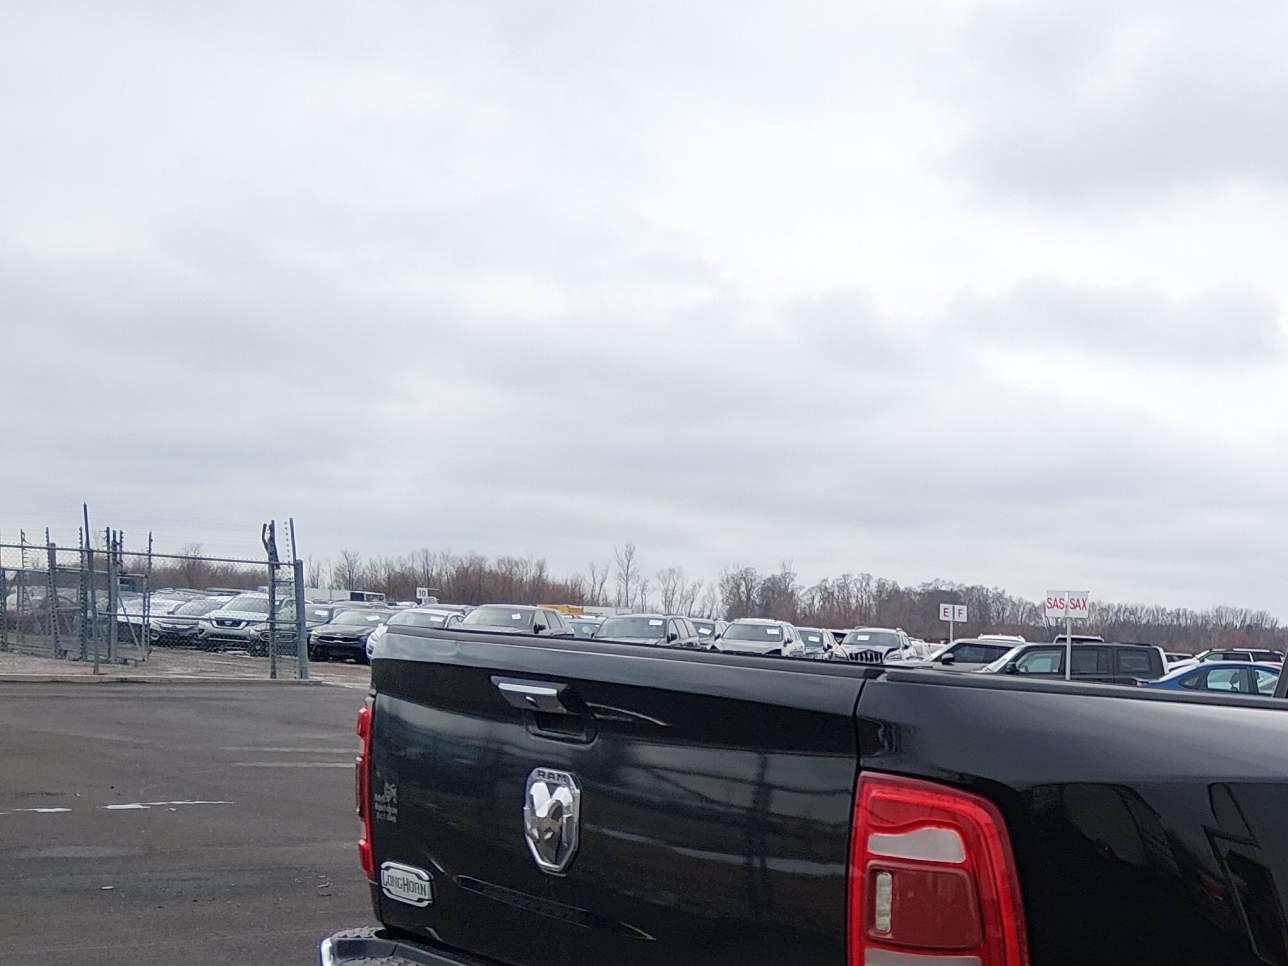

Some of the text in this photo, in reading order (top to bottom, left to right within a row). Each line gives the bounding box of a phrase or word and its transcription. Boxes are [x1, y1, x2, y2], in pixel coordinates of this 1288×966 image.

[1046, 597, 1088, 610] SAS SAX
[943, 607, 963, 618] E F
[537, 770, 570, 785] RAM
